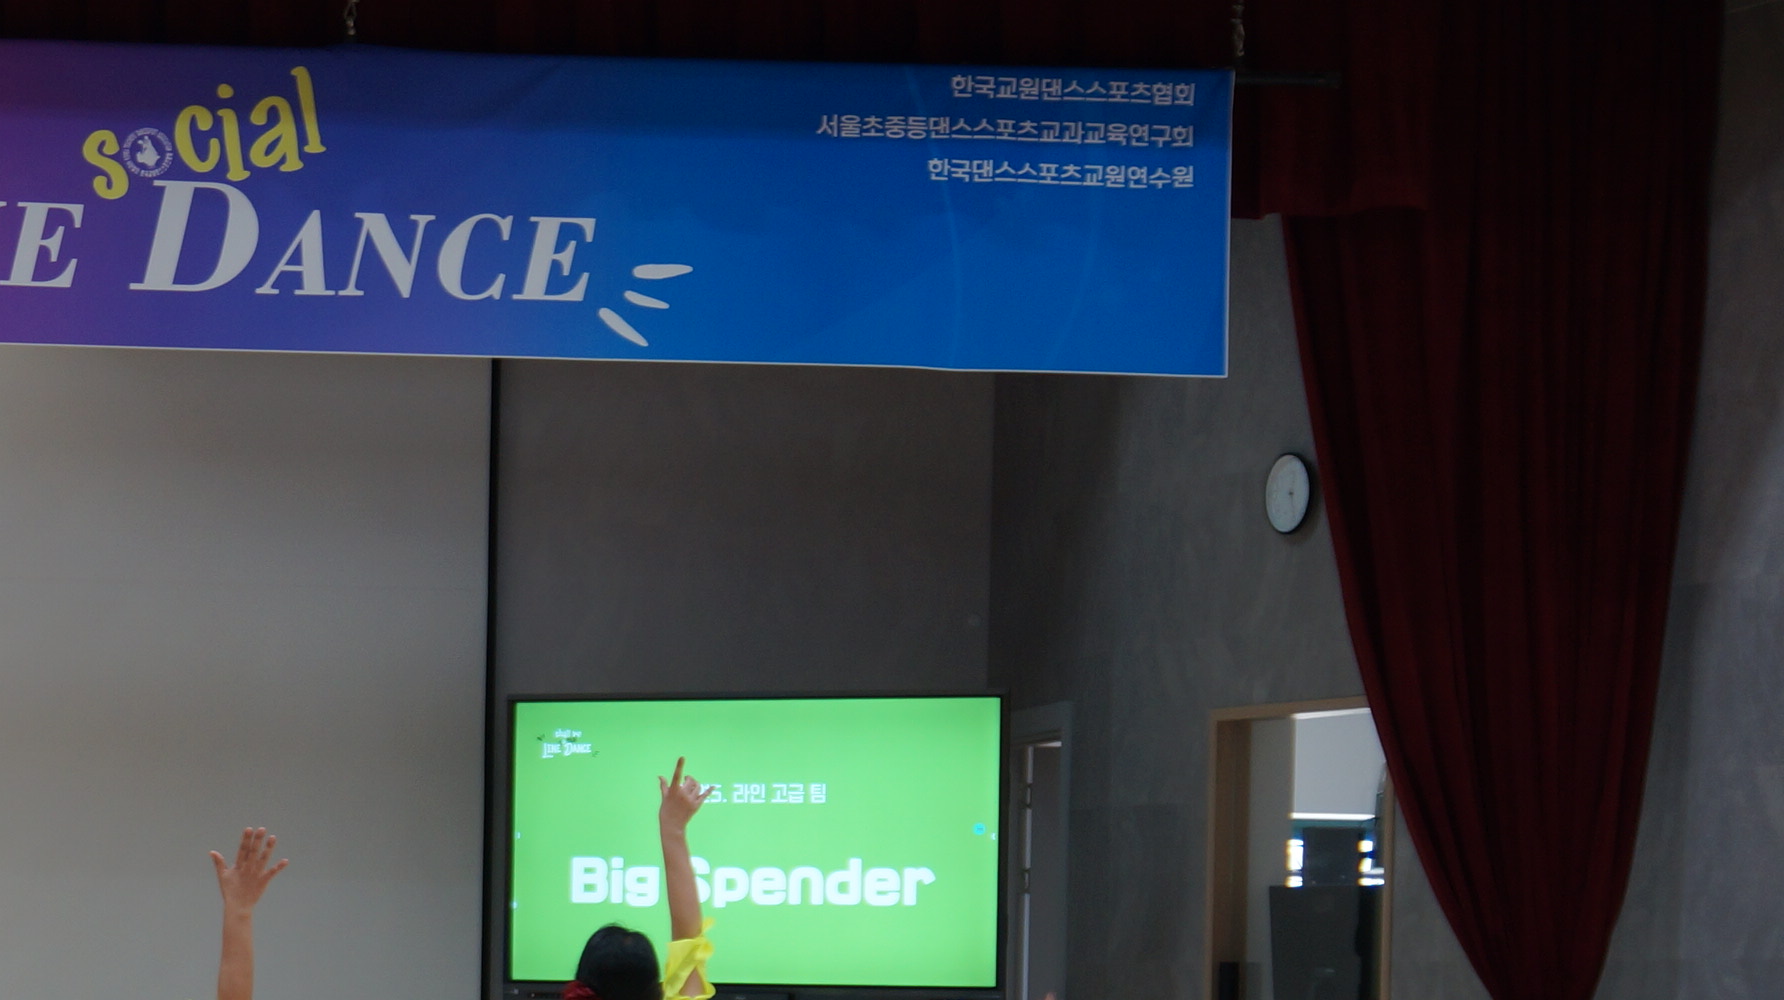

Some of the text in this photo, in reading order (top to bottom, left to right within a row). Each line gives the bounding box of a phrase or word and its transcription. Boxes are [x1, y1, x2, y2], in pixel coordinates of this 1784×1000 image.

[951, 74, 1196, 106] 한국교원댄스스포츠협회
[816, 114, 1195, 148] 서울초중등댄스스포츠교과교육연구회
[927, 157, 1195, 189] 한국댄스스포츠교원연수원
[128, 179, 597, 302] DANCE
[732, 783, 766, 804] 라인
[771, 783, 805, 804] 고급
[809, 783, 827, 804] 팀
[571, 857, 660, 907] Big
